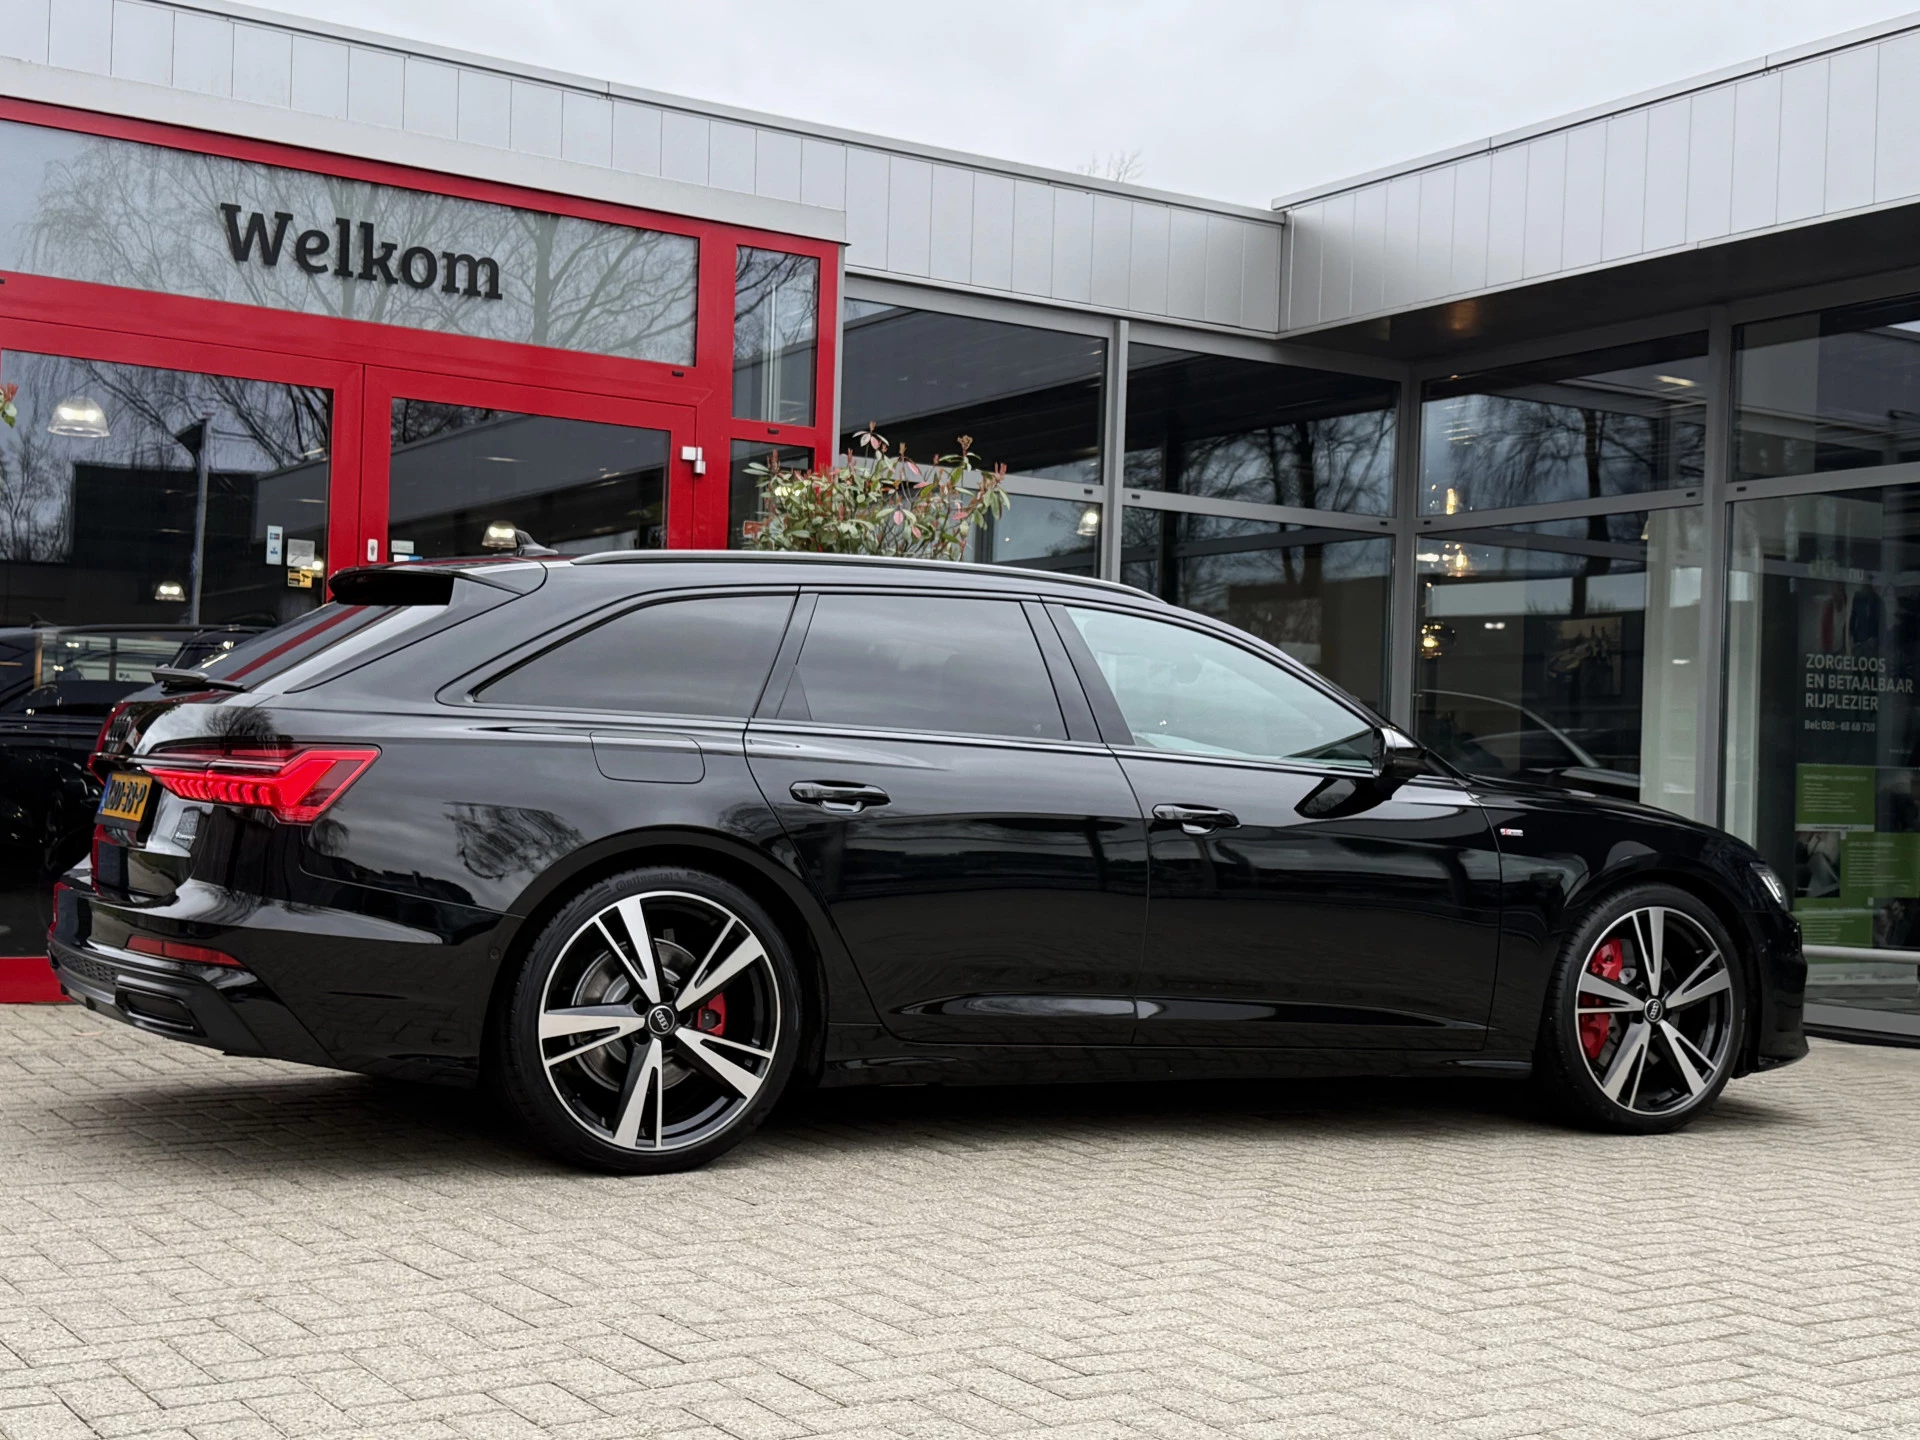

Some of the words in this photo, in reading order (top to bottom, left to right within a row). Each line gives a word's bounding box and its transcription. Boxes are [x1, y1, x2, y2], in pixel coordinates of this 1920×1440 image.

[220, 202, 503, 300] Welkom
[1806, 653, 1886, 673] ZORGELOOS
[1806, 673, 1825, 689] EN
[1828, 675, 1914, 694] BETAALBAAR
[1805, 693, 1879, 711] RIJPLEZIER
